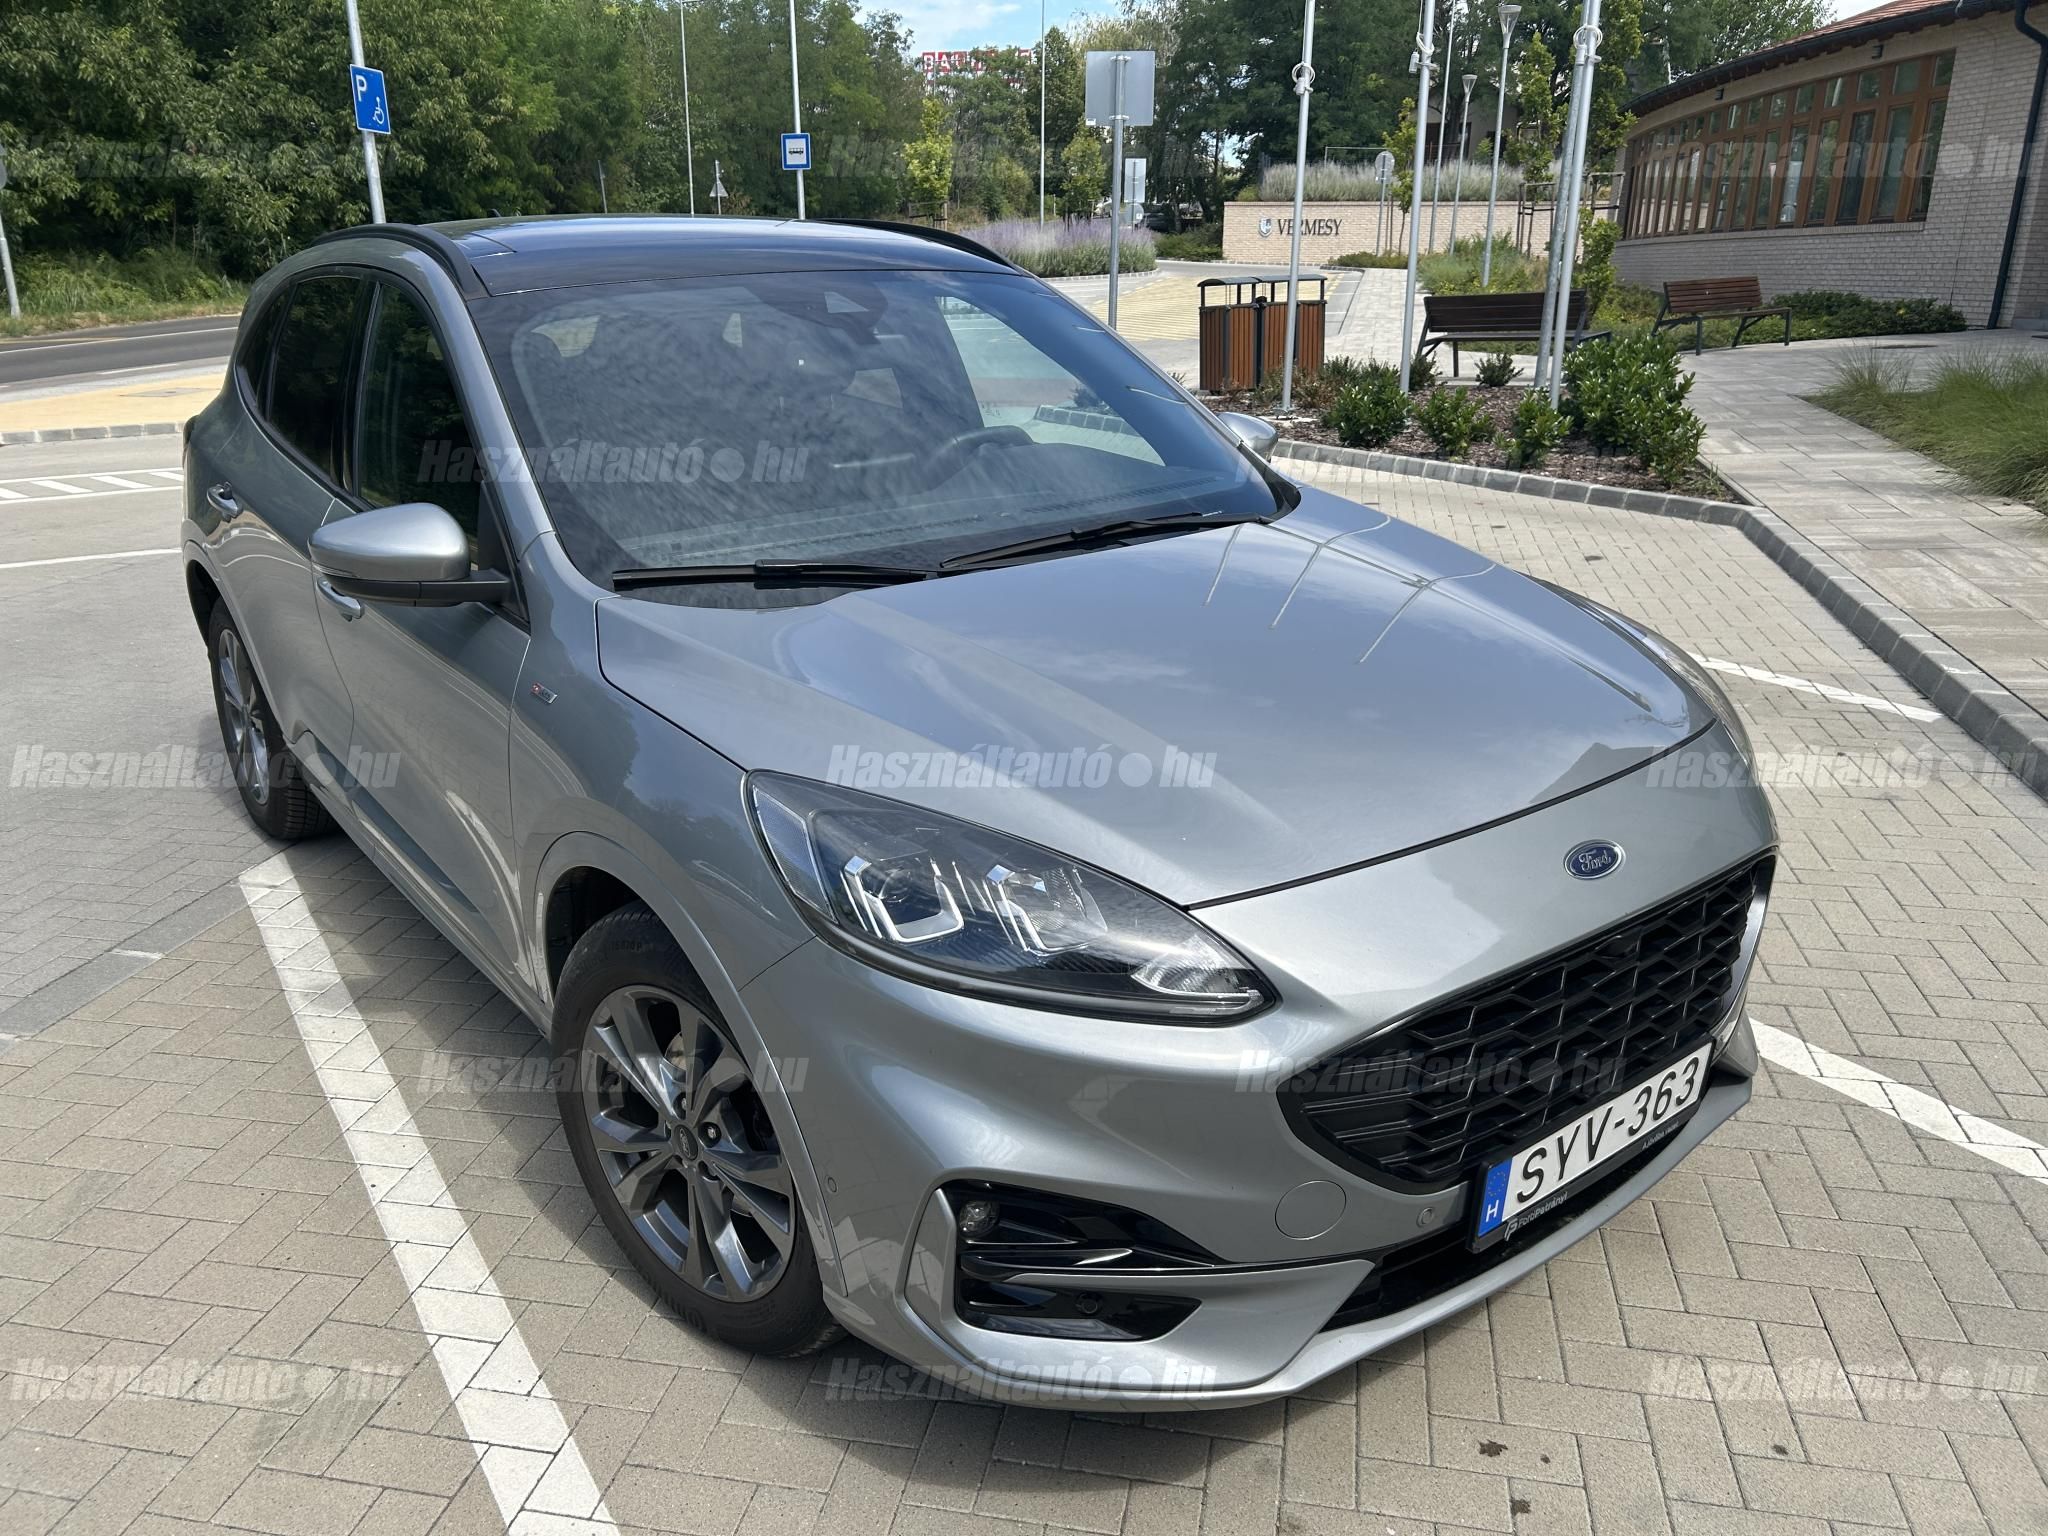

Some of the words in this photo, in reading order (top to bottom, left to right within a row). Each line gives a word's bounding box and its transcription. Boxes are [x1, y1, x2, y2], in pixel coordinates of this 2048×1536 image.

[356, 74, 367, 102] P
[1277, 218, 1342, 236] VEMESY
[1579, 849, 1612, 873] Ford
[1516, 1056, 1700, 1204] SYV-363
[1485, 1199, 1500, 1223] H
